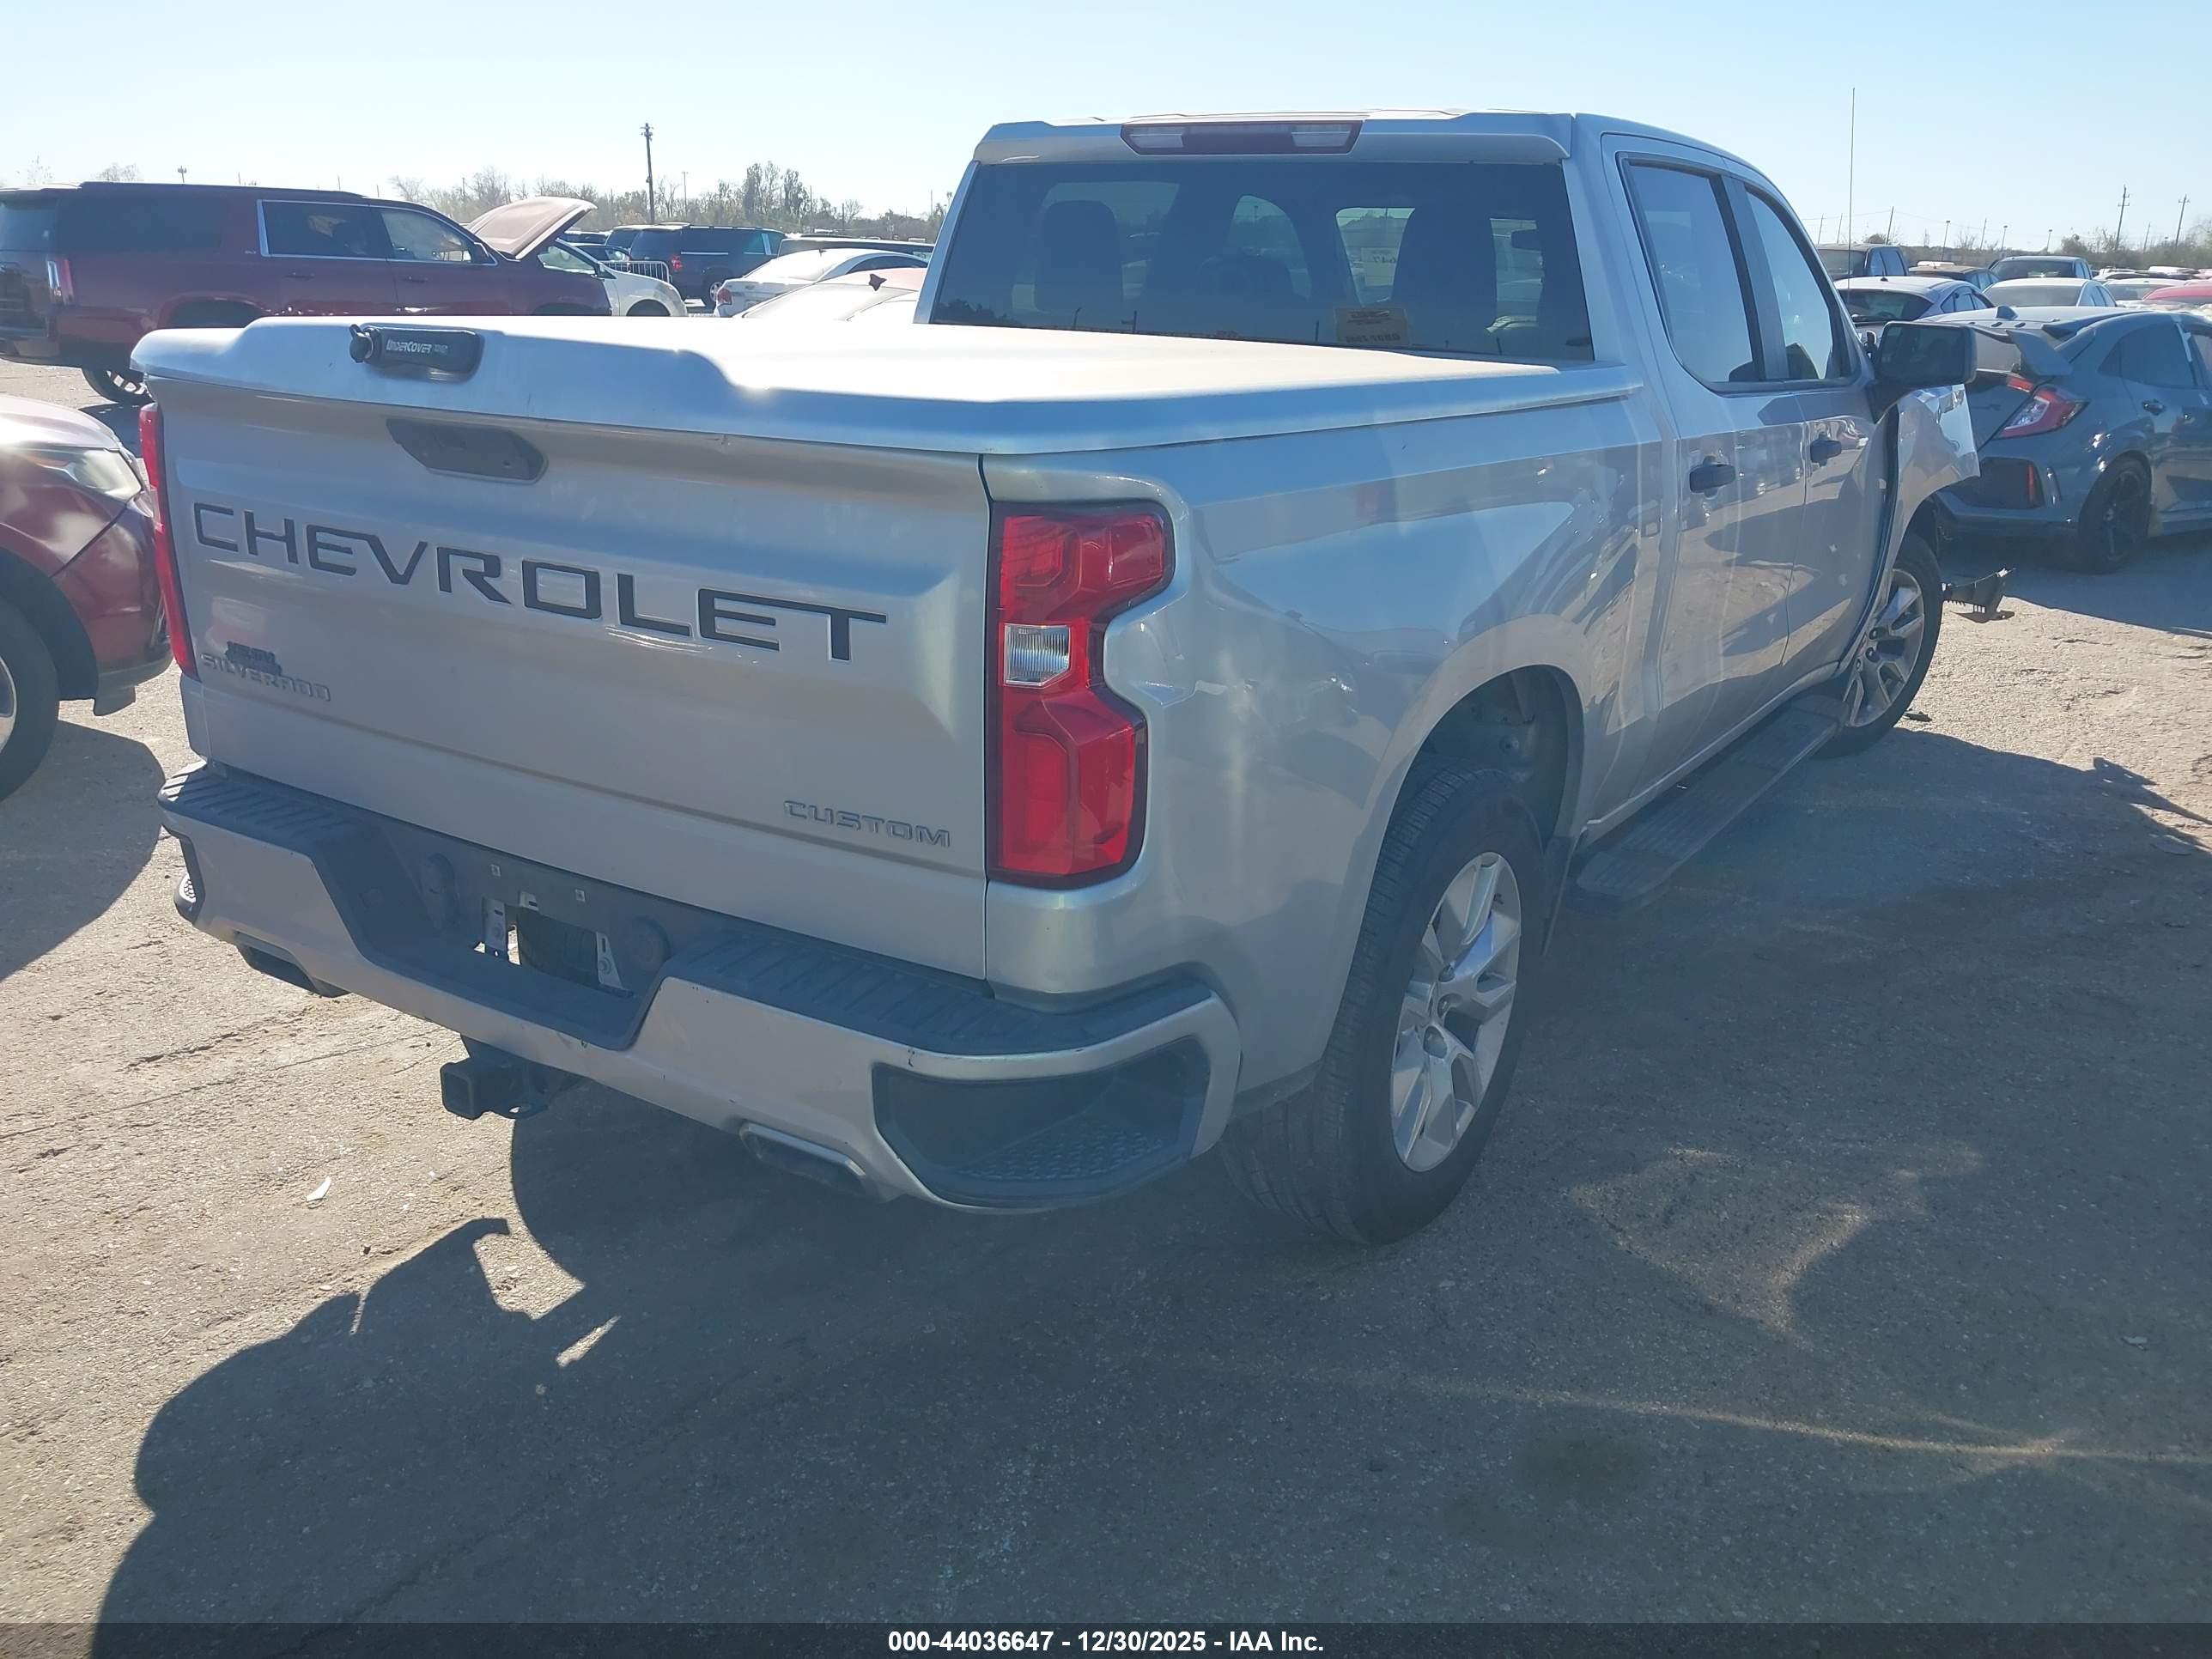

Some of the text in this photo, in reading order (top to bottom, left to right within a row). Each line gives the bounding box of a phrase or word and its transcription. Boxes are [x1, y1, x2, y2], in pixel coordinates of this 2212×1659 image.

[193, 501, 889, 662] CHEVROLET
[200, 653, 331, 702] SILVERADO
[783, 799, 951, 848] CUSTOM
